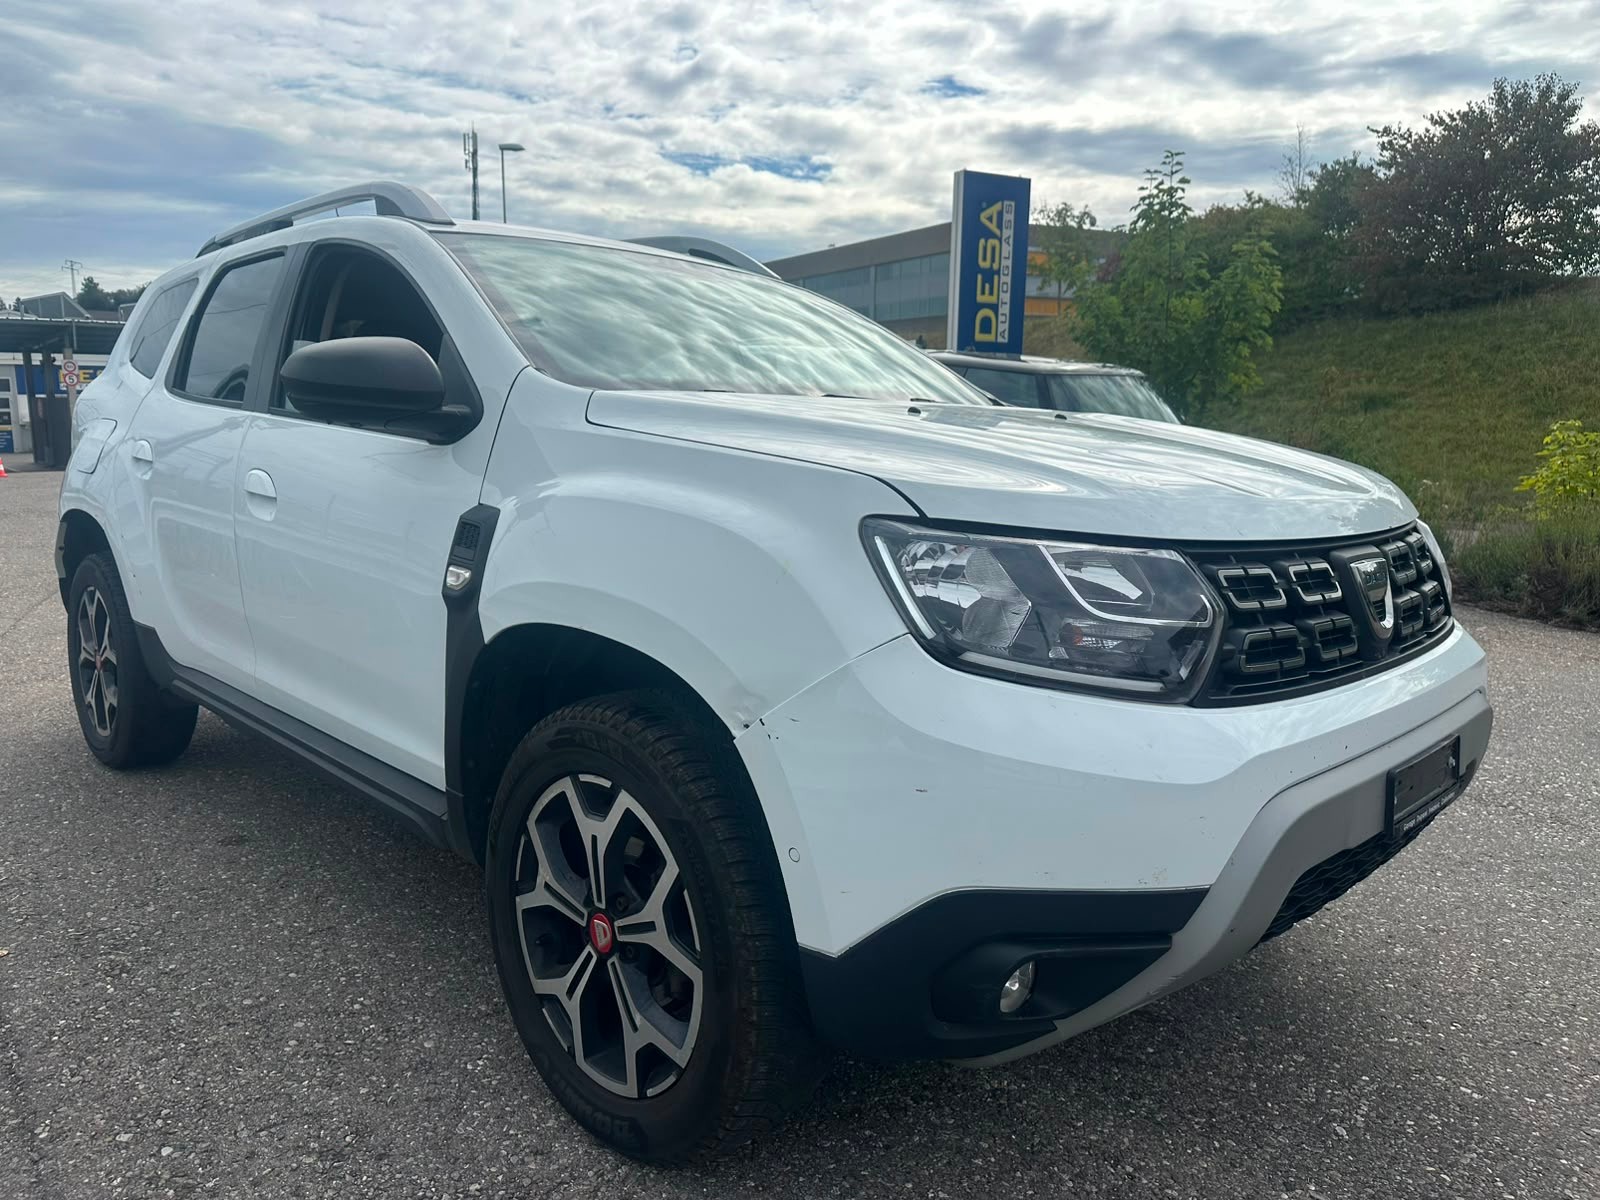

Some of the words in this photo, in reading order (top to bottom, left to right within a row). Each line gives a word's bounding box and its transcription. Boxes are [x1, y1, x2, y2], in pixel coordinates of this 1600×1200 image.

[975, 201, 1002, 342] DESA
[999, 203, 1014, 340] AUTOGLASS
[68, 375, 75, 384] 5
